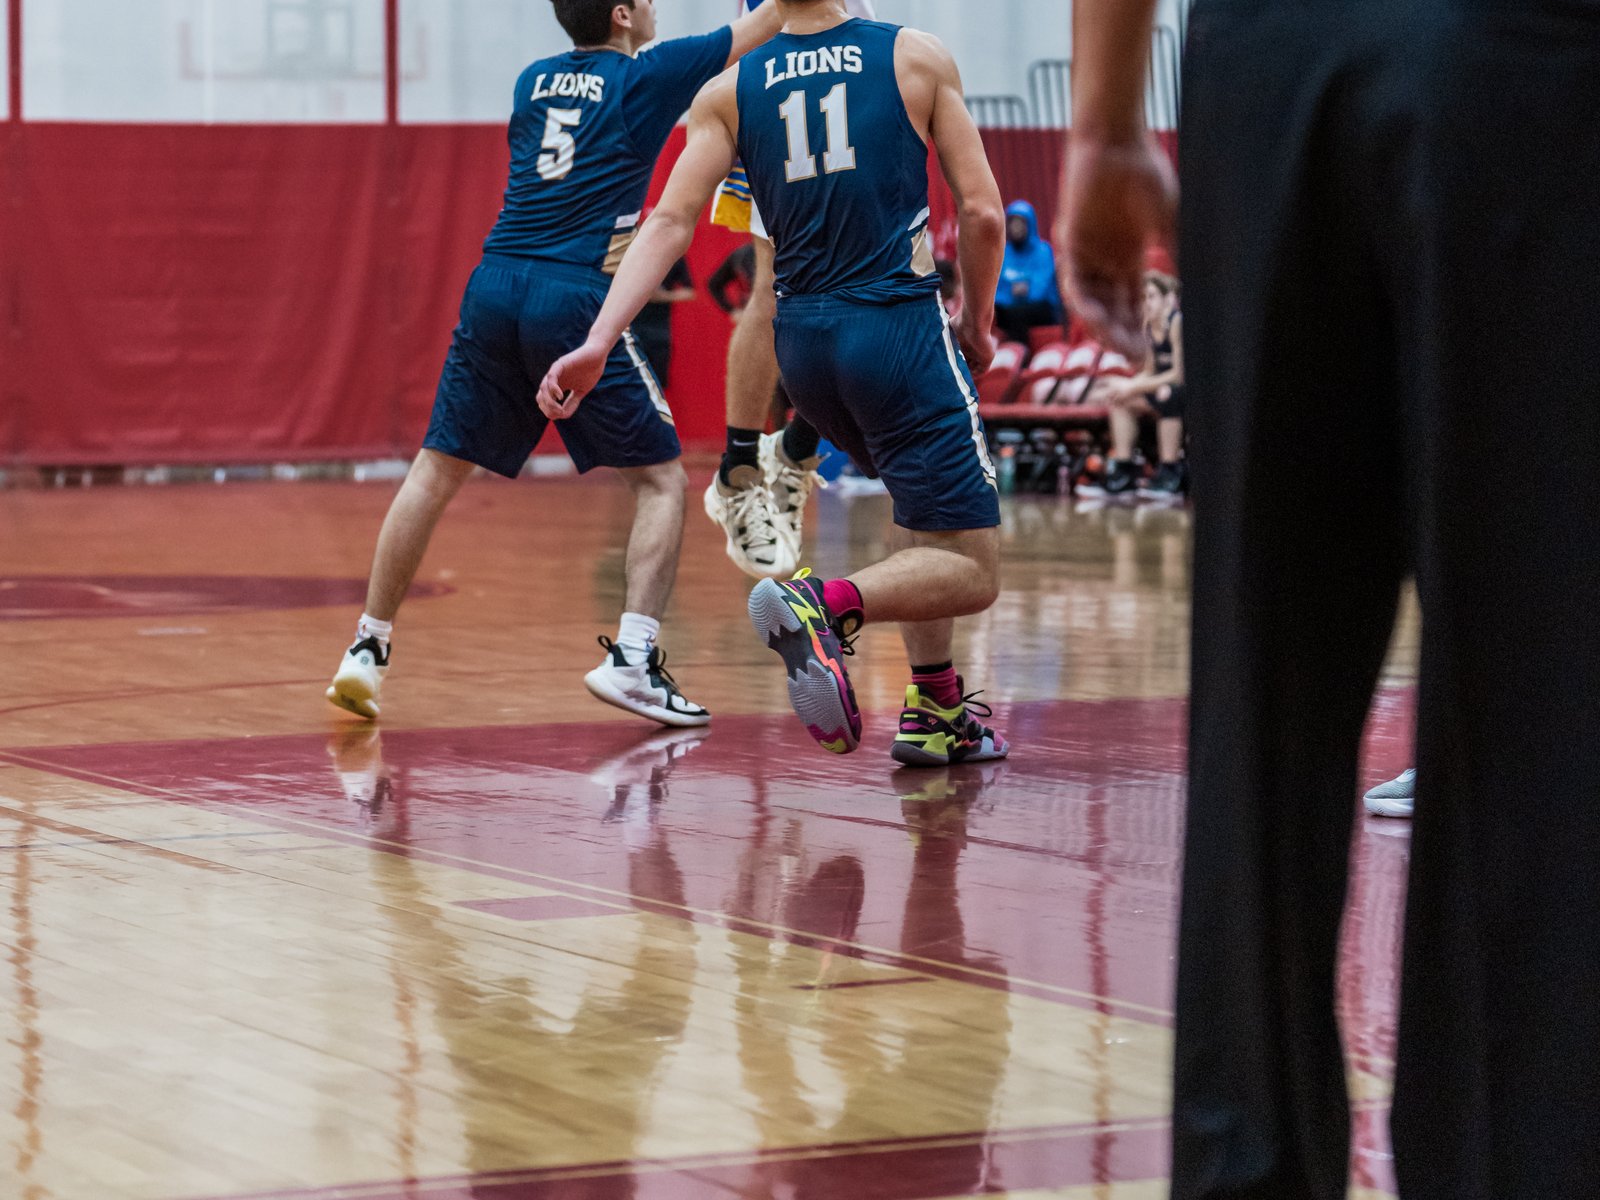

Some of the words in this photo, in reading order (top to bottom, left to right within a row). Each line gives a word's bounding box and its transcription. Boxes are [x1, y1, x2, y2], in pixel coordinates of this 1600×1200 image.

[530, 72, 604, 102] LIONS
[764, 45, 863, 90] LIONS
[536, 107, 582, 180] 5
[778, 82, 857, 184] 11
